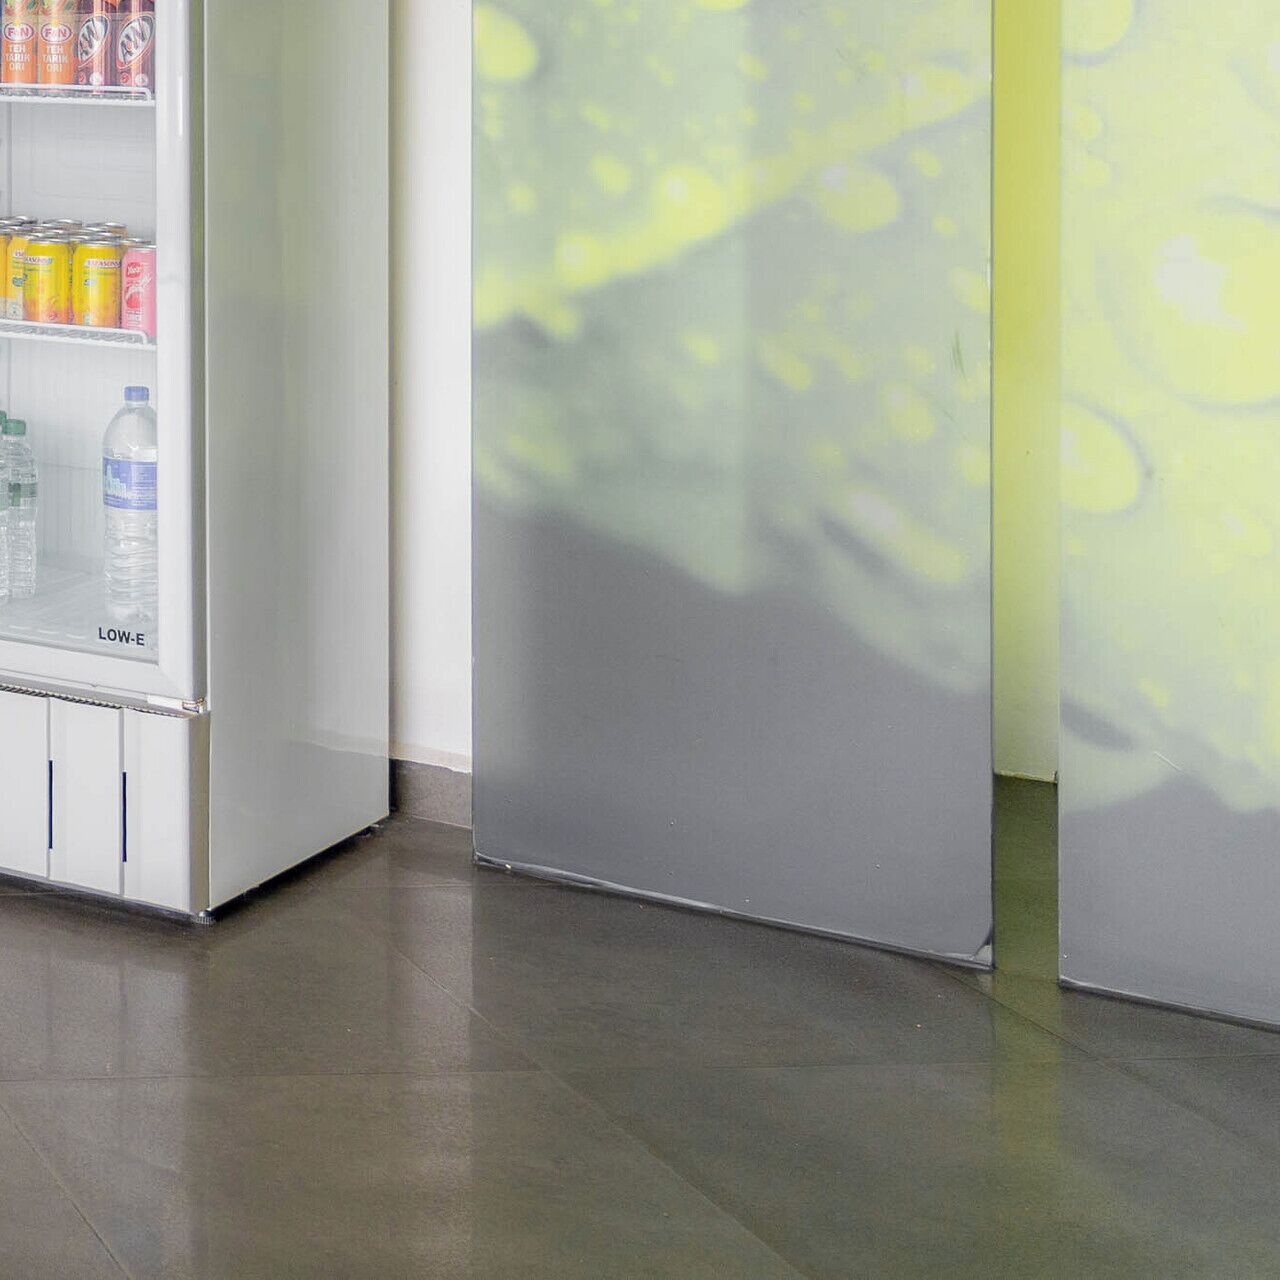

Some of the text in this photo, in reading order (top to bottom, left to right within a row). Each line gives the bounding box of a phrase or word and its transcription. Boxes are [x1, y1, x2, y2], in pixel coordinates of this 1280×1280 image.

[9, 44, 26, 53] TEH
[46, 45, 64, 54] TEH
[6, 53, 30, 62] TARIK
[43, 54, 68, 63] TARIK
[98, 627, 145, 646] LOW-E
